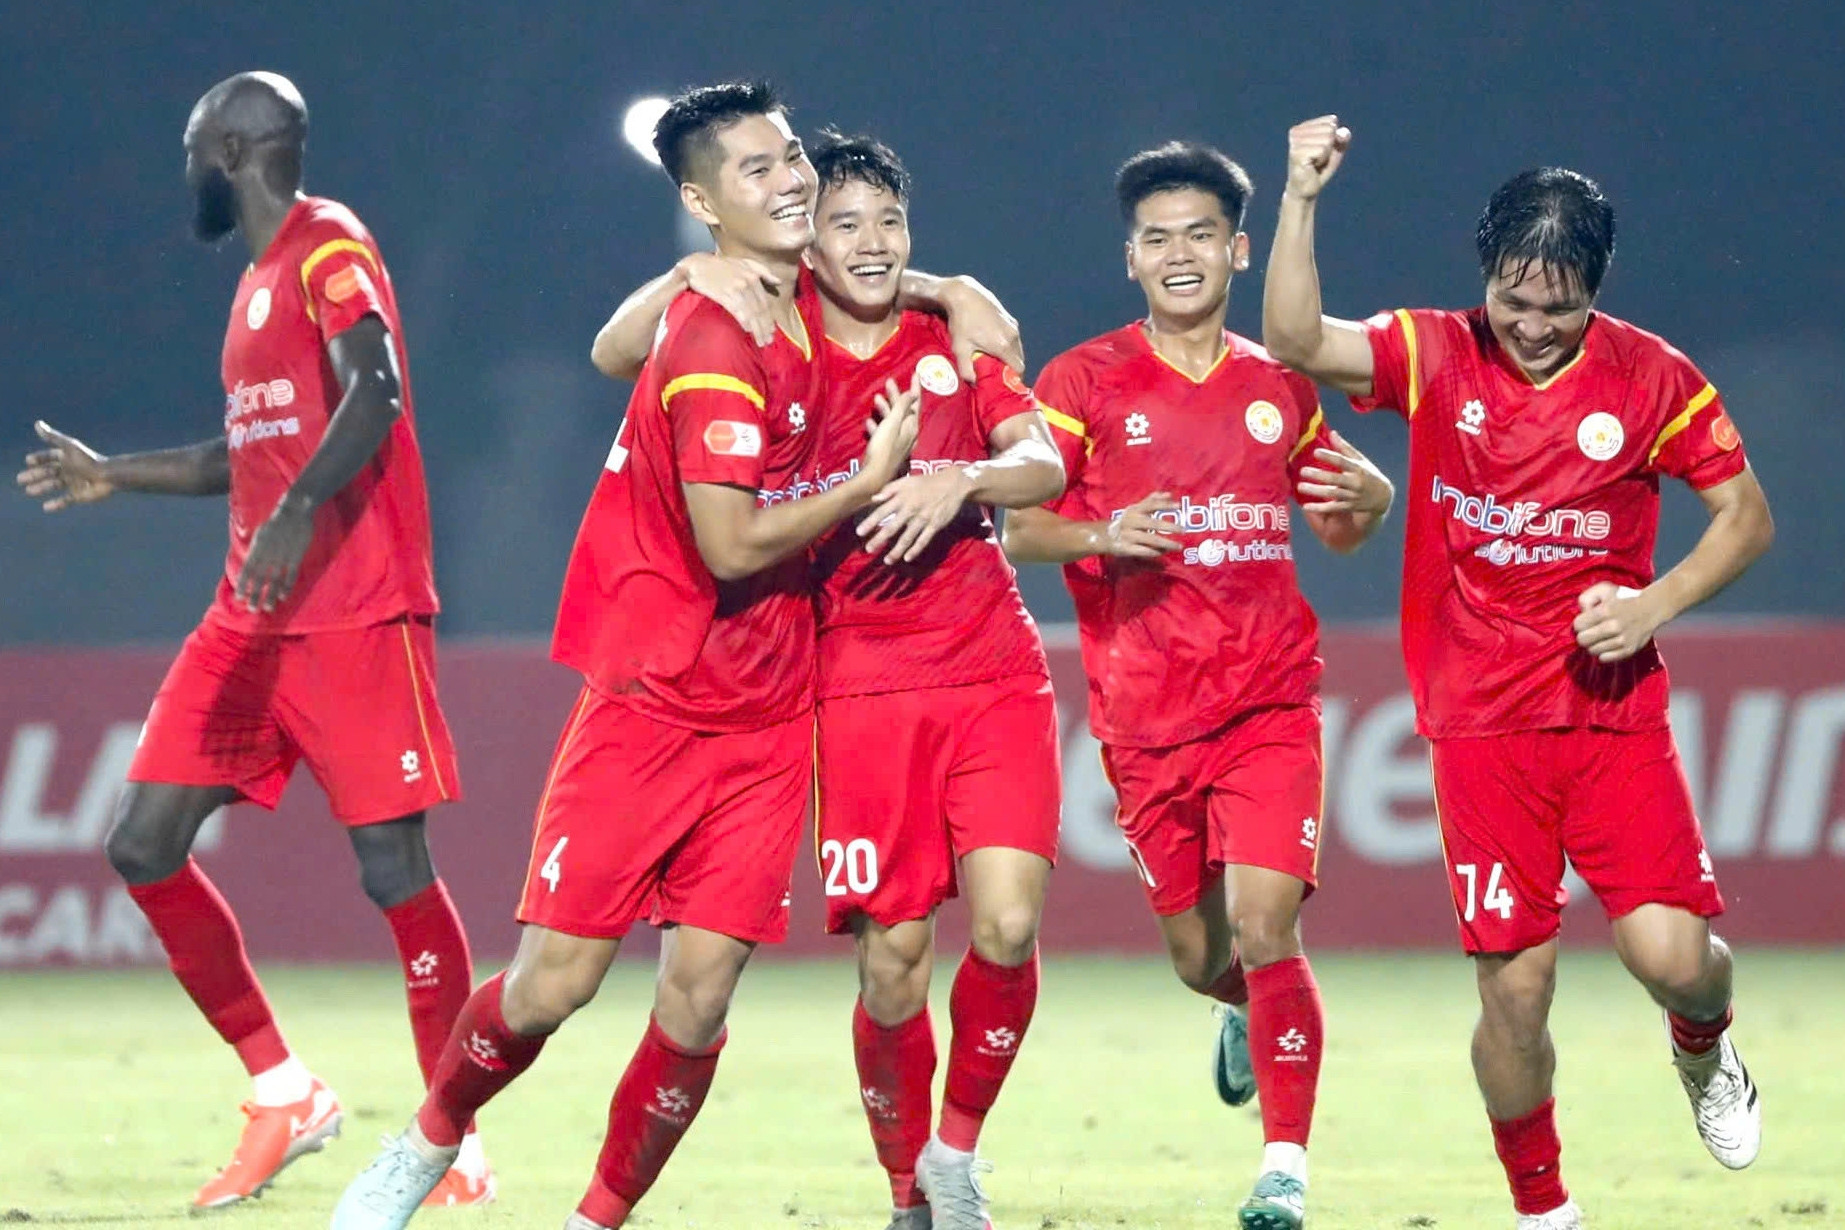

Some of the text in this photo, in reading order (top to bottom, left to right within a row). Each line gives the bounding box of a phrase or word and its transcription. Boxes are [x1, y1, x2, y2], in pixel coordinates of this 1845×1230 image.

[540, 836, 569, 893] 4
[821, 838, 879, 896] 20
[1456, 862, 1514, 922] 74
